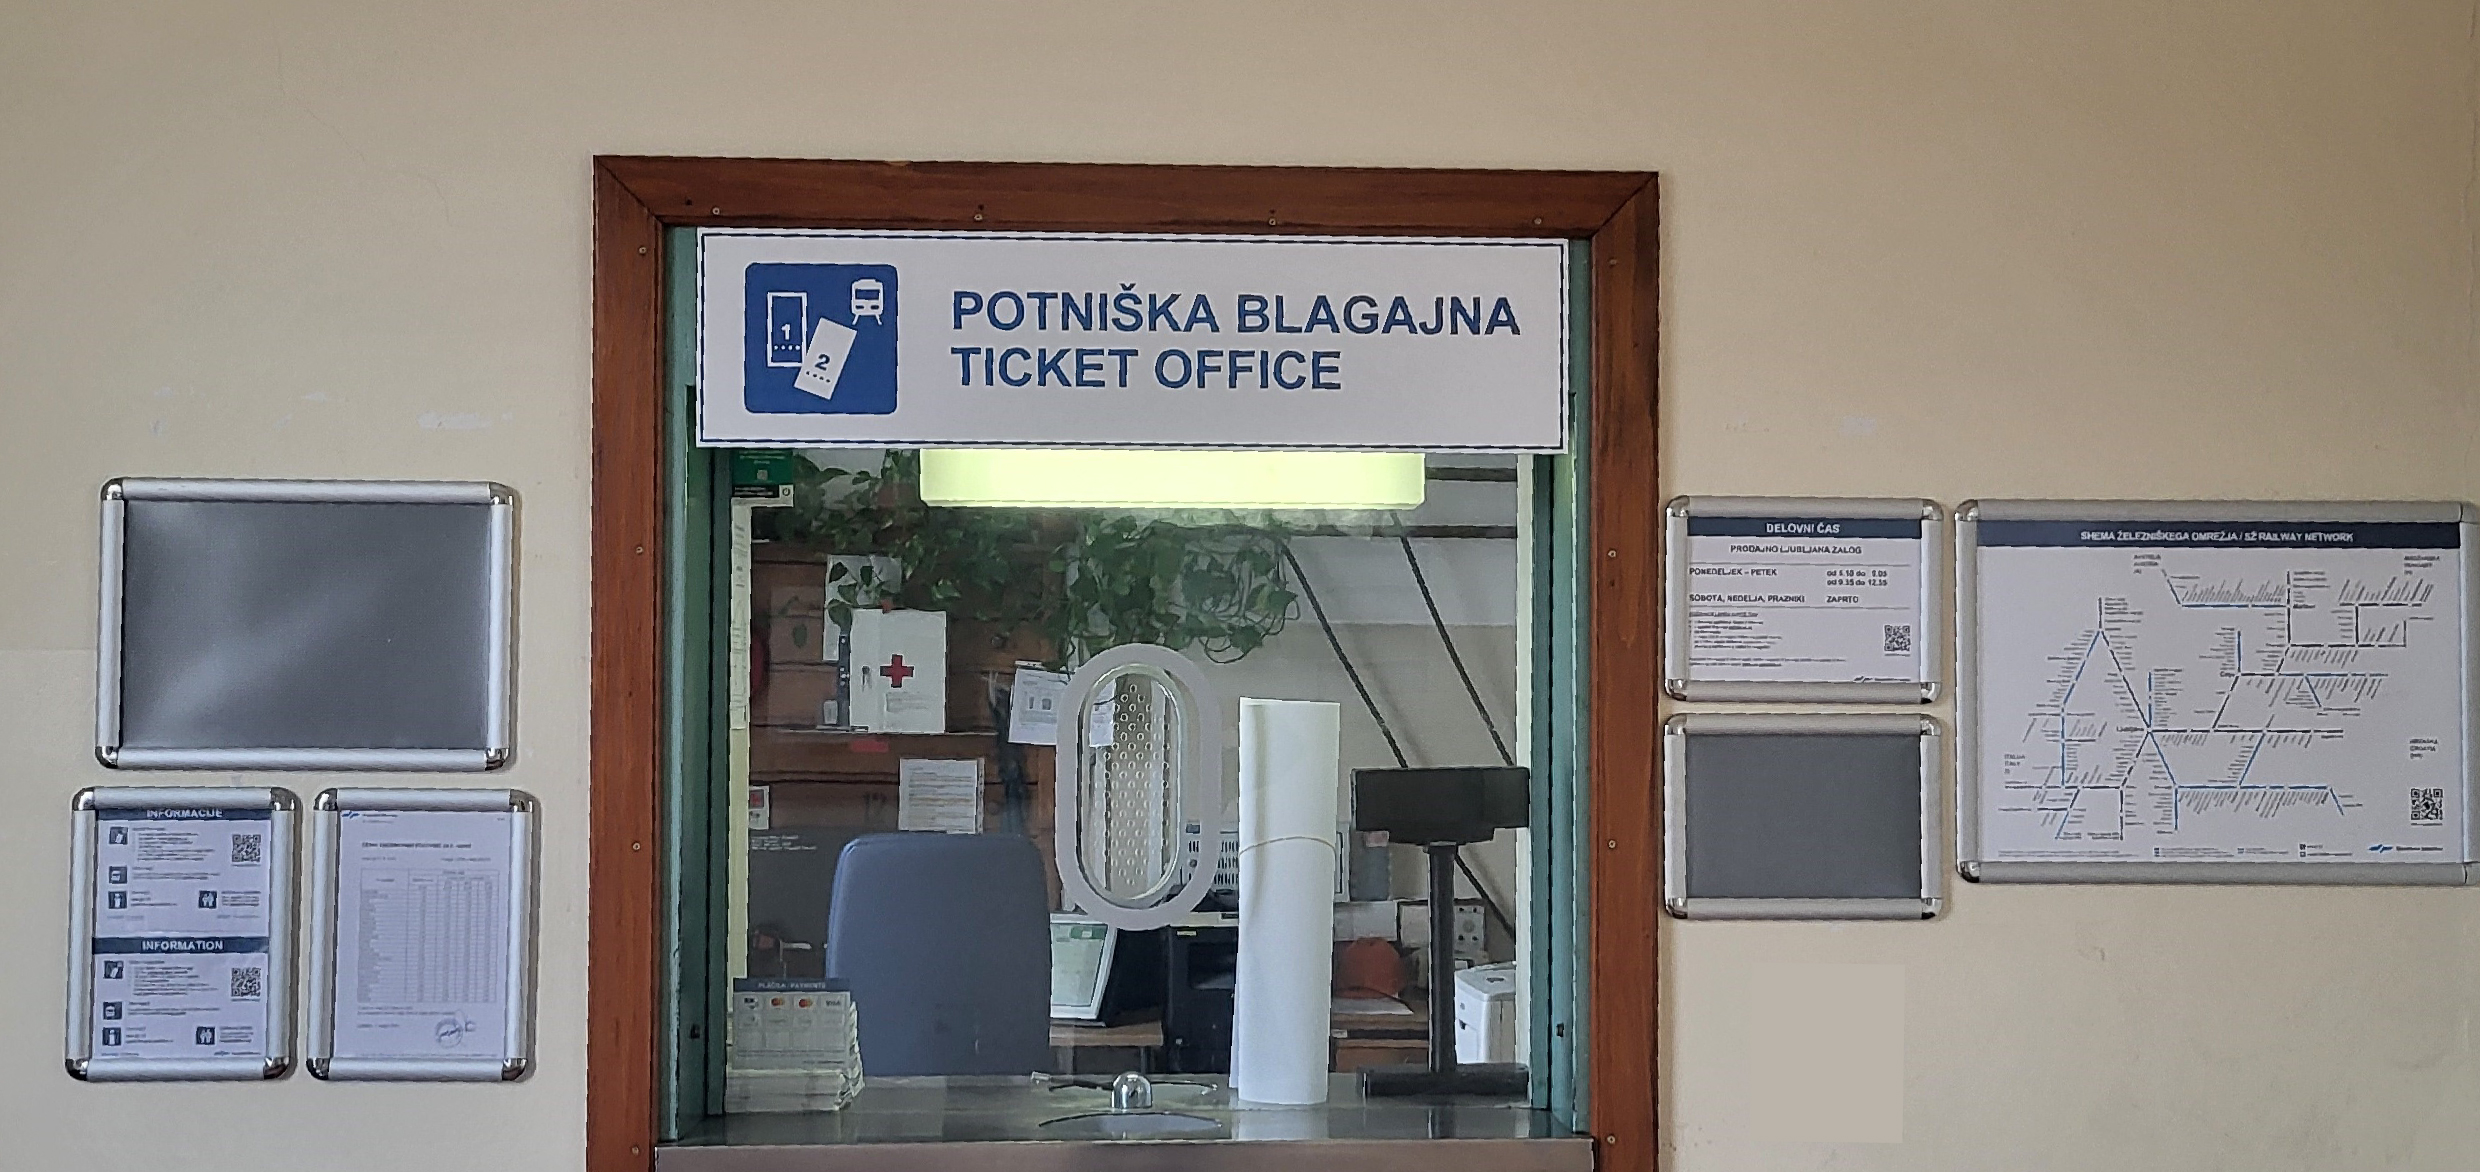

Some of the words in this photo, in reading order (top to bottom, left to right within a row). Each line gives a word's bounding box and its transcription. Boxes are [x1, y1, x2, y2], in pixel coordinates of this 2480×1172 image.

[952, 283, 1220, 334] POTNIŠKA
[1238, 294, 1521, 336] BLAGAJNA
[780, 323, 791, 341] 1
[814, 353, 831, 371] 2
[951, 347, 1139, 390] TICKET
[1155, 349, 1342, 391] OFFICE
[1766, 522, 1815, 534] DELOVNI
[1816, 521, 1841, 534] ČAS
[2080, 531, 2116, 541] SHEMA
[2117, 529, 2190, 541] ŽELEZNIŠKEGA
[2191, 531, 2239, 542] OMREŽJA
[2258, 532, 2302, 542] RAILWAY
[2304, 532, 2354, 543] NETWORK
[1730, 545, 1779, 554] PRODAJNO
[1780, 545, 1831, 554] LJUBLJANA
[1831, 546, 1863, 555] ZALOG
[1689, 567, 1743, 577] PONEDELJEK
[1750, 568, 1778, 577] PETEK
[1689, 593, 1726, 603] SOBOTA,
[1727, 594, 1766, 604] NEDELJA,
[1767, 594, 1806, 603] PRAZNIKI
[1826, 595, 1859, 604] ZAPRTO
[146, 808, 223, 819] INFORMACIJE
[142, 940, 224, 951] INFORMATION
